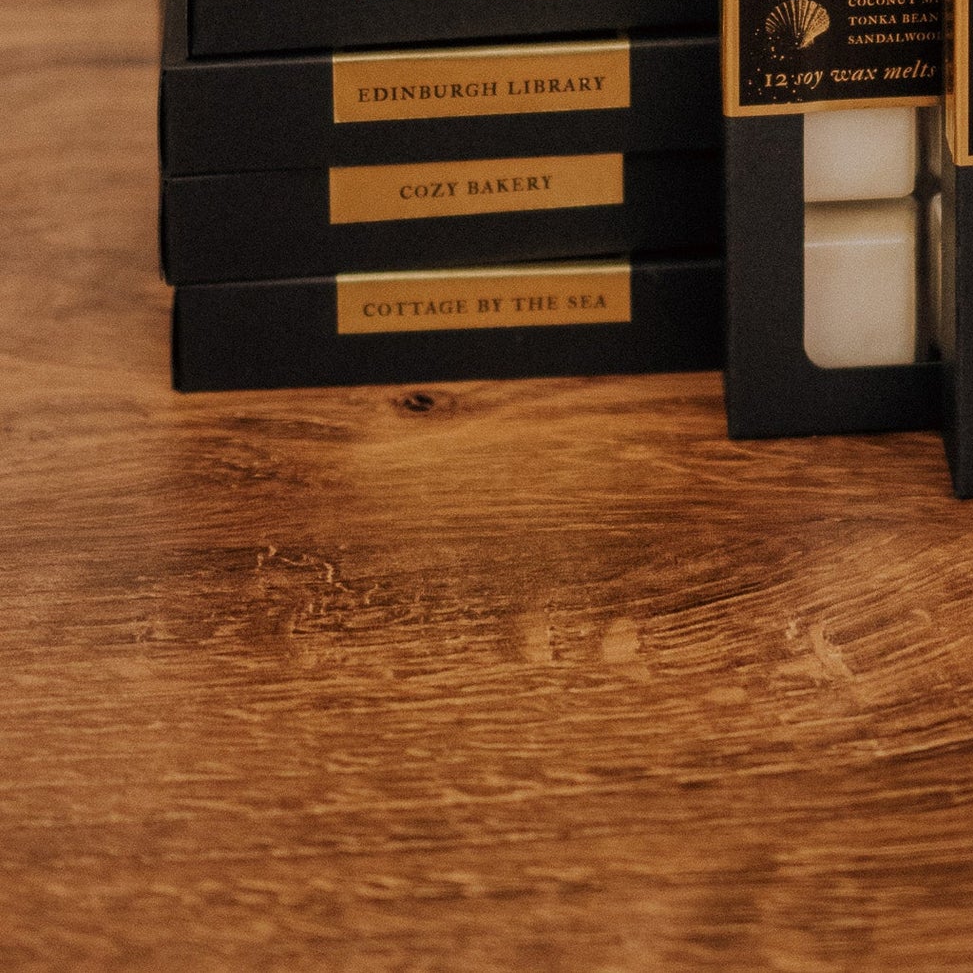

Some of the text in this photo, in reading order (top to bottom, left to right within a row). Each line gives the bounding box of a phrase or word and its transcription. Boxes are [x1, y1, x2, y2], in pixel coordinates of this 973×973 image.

[848, 13, 939, 26] TONKA BEAN
[765, 59, 937, 90] 12 soy wax melts
[358, 77, 606, 103] EDINBURGH LIBRARY
[400, 175, 553, 200] COZY BAKERY
[363, 295, 607, 317] COTTAGE BY THE SEA
